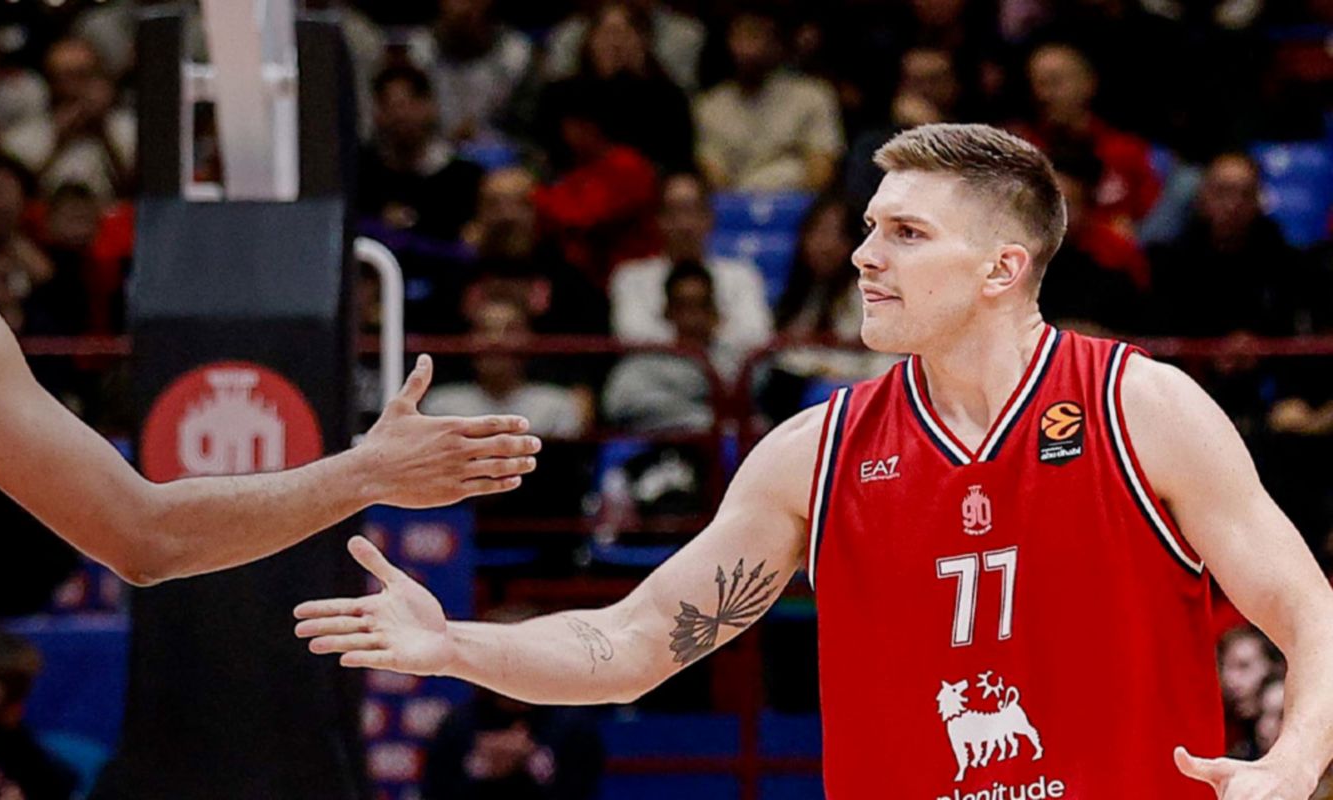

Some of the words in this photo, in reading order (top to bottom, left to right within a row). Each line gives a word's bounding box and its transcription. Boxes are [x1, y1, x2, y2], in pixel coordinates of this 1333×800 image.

[861, 455, 899, 478] EA7
[962, 494, 992, 528] 90
[936, 545, 1018, 648] 77
[936, 775, 1065, 800] nitude
